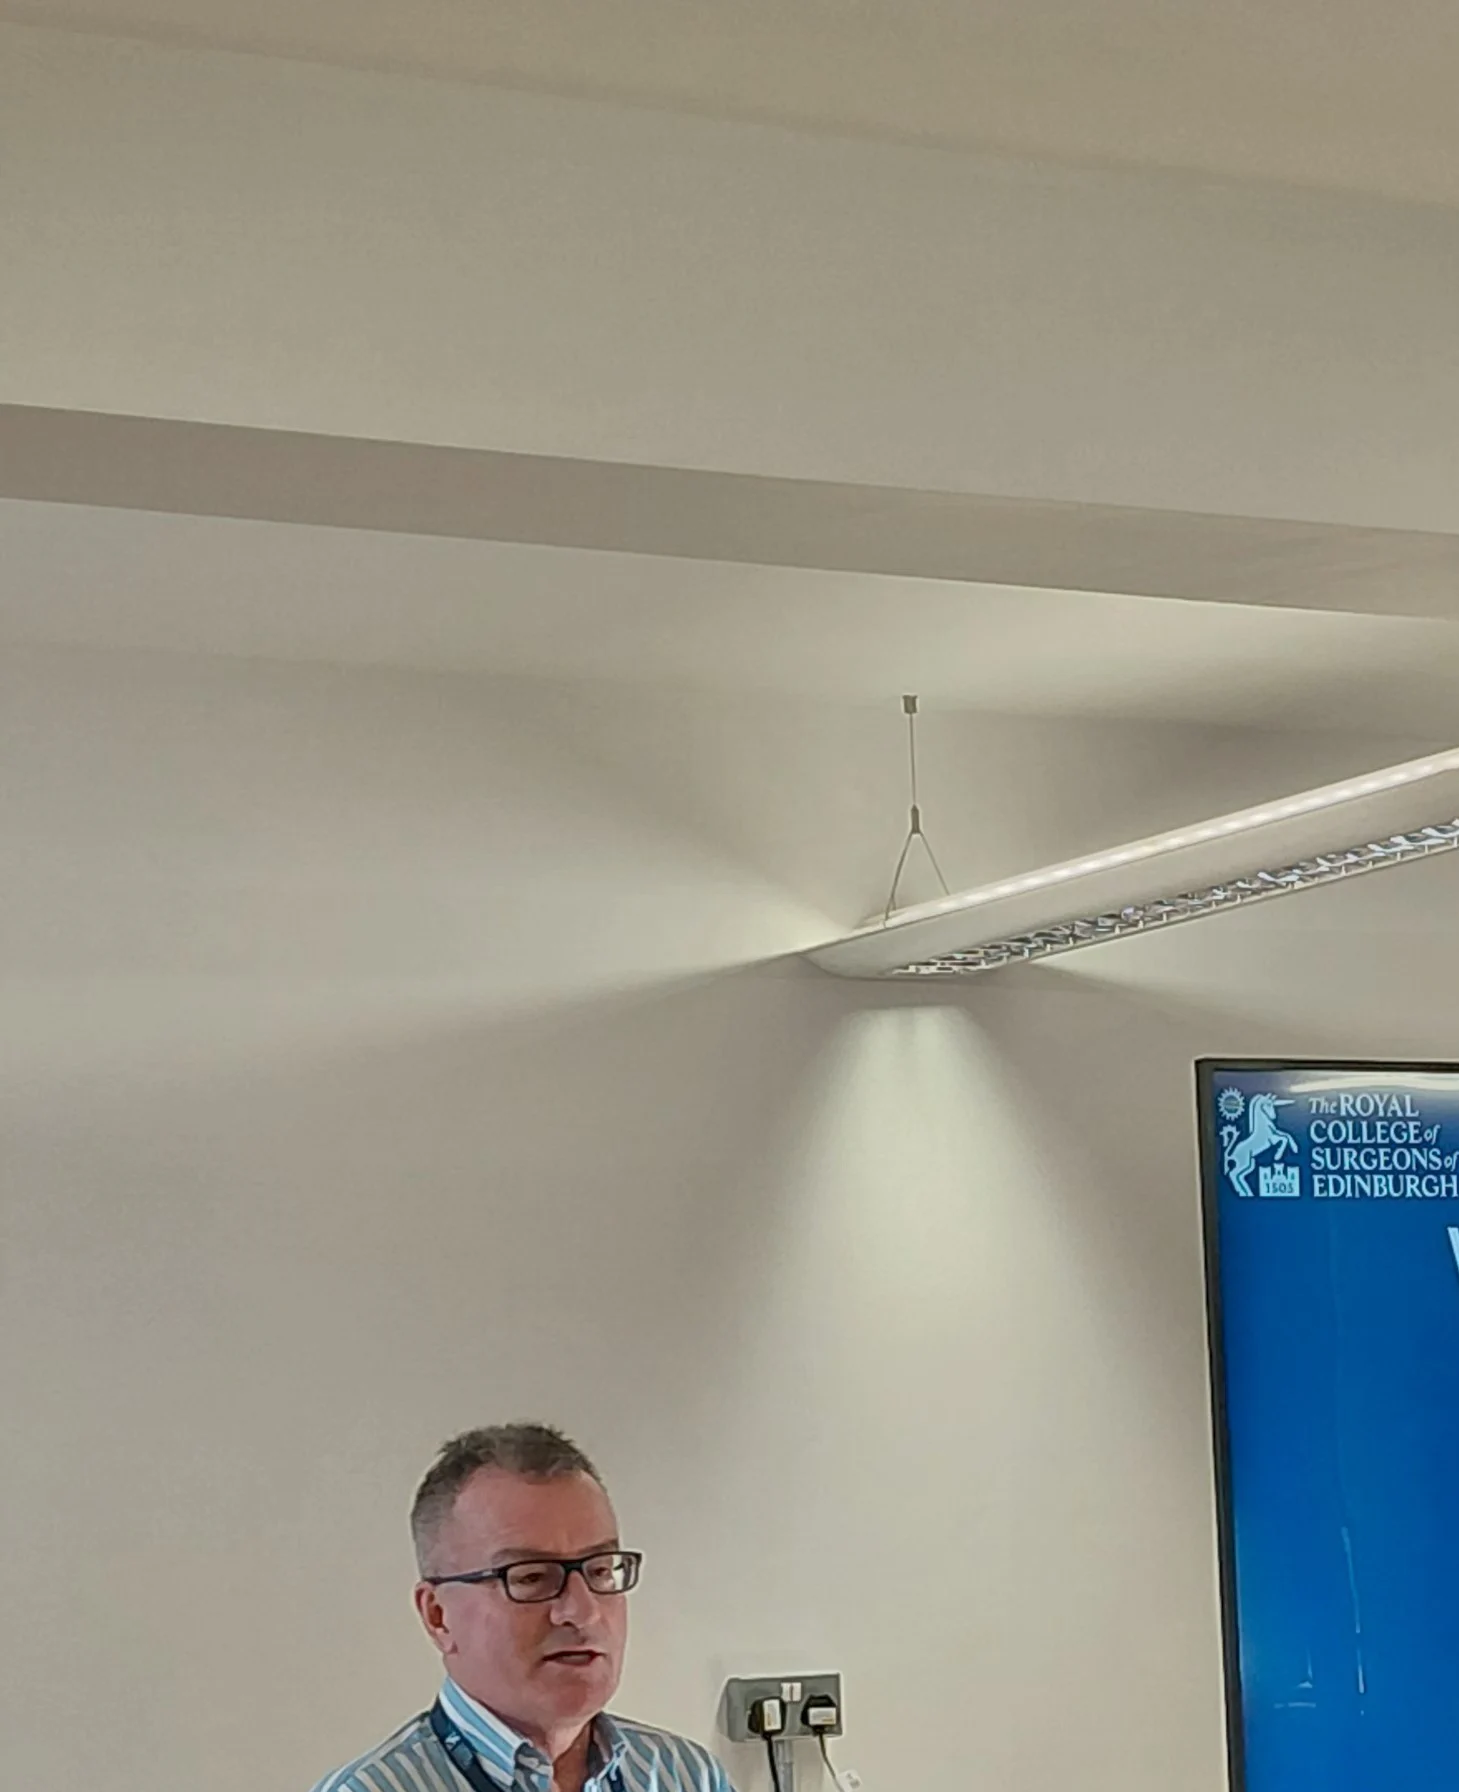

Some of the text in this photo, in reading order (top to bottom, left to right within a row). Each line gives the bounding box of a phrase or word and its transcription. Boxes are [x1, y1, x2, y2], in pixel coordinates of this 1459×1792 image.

[1308, 1093, 1419, 1117] The ROYAL
[1309, 1120, 1441, 1145] COLLEGE of
[1310, 1147, 1459, 1172] SURGEONS of
[1265, 1182, 1294, 1194] 1505
[1312, 1174, 1459, 1198] EDINBURGH
